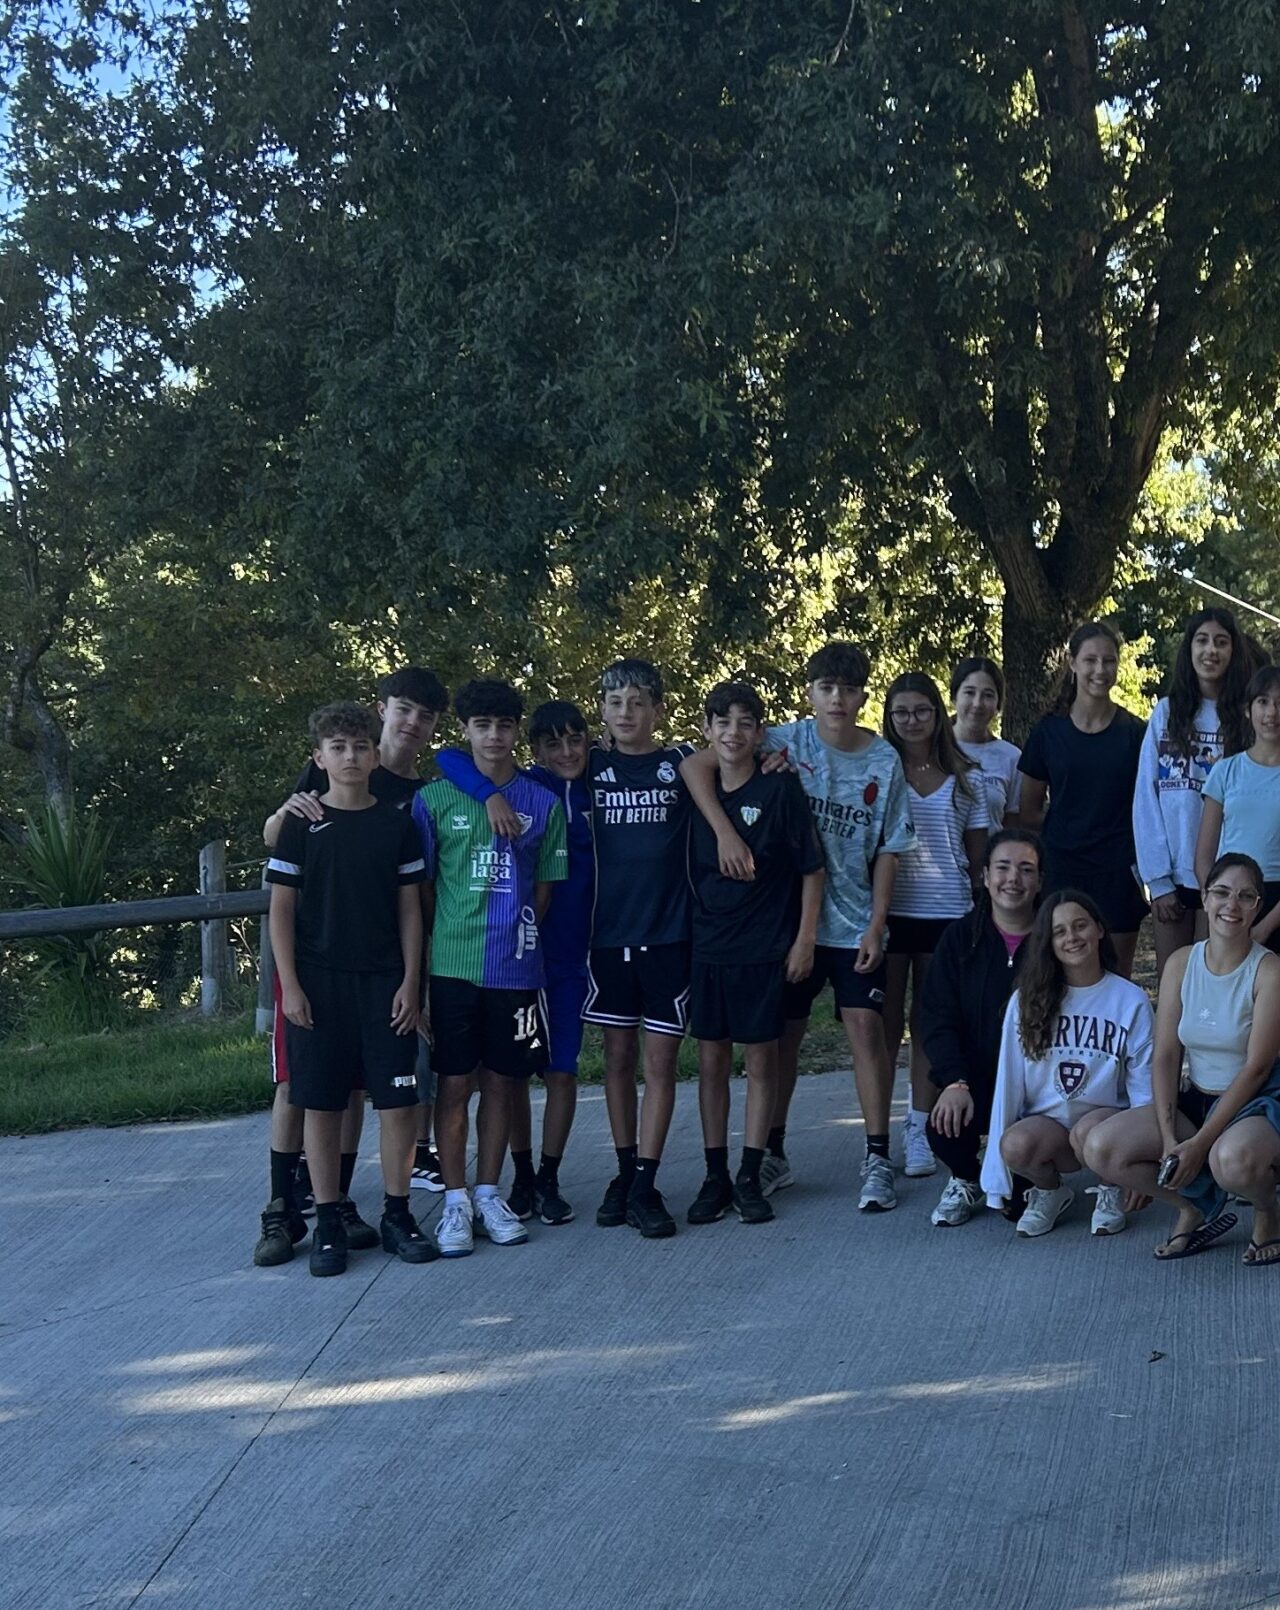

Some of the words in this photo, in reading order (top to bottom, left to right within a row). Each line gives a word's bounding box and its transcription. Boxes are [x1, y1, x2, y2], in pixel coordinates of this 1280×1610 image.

[594, 787, 680, 808] Emirates
[807, 795, 874, 827] mirates
[604, 808, 623, 825] FLY
[625, 806, 667, 824] BETTER
[471, 859, 512, 884] laga
[513, 1003, 538, 1041] 10
[1053, 1014, 1129, 1058] RVARD
